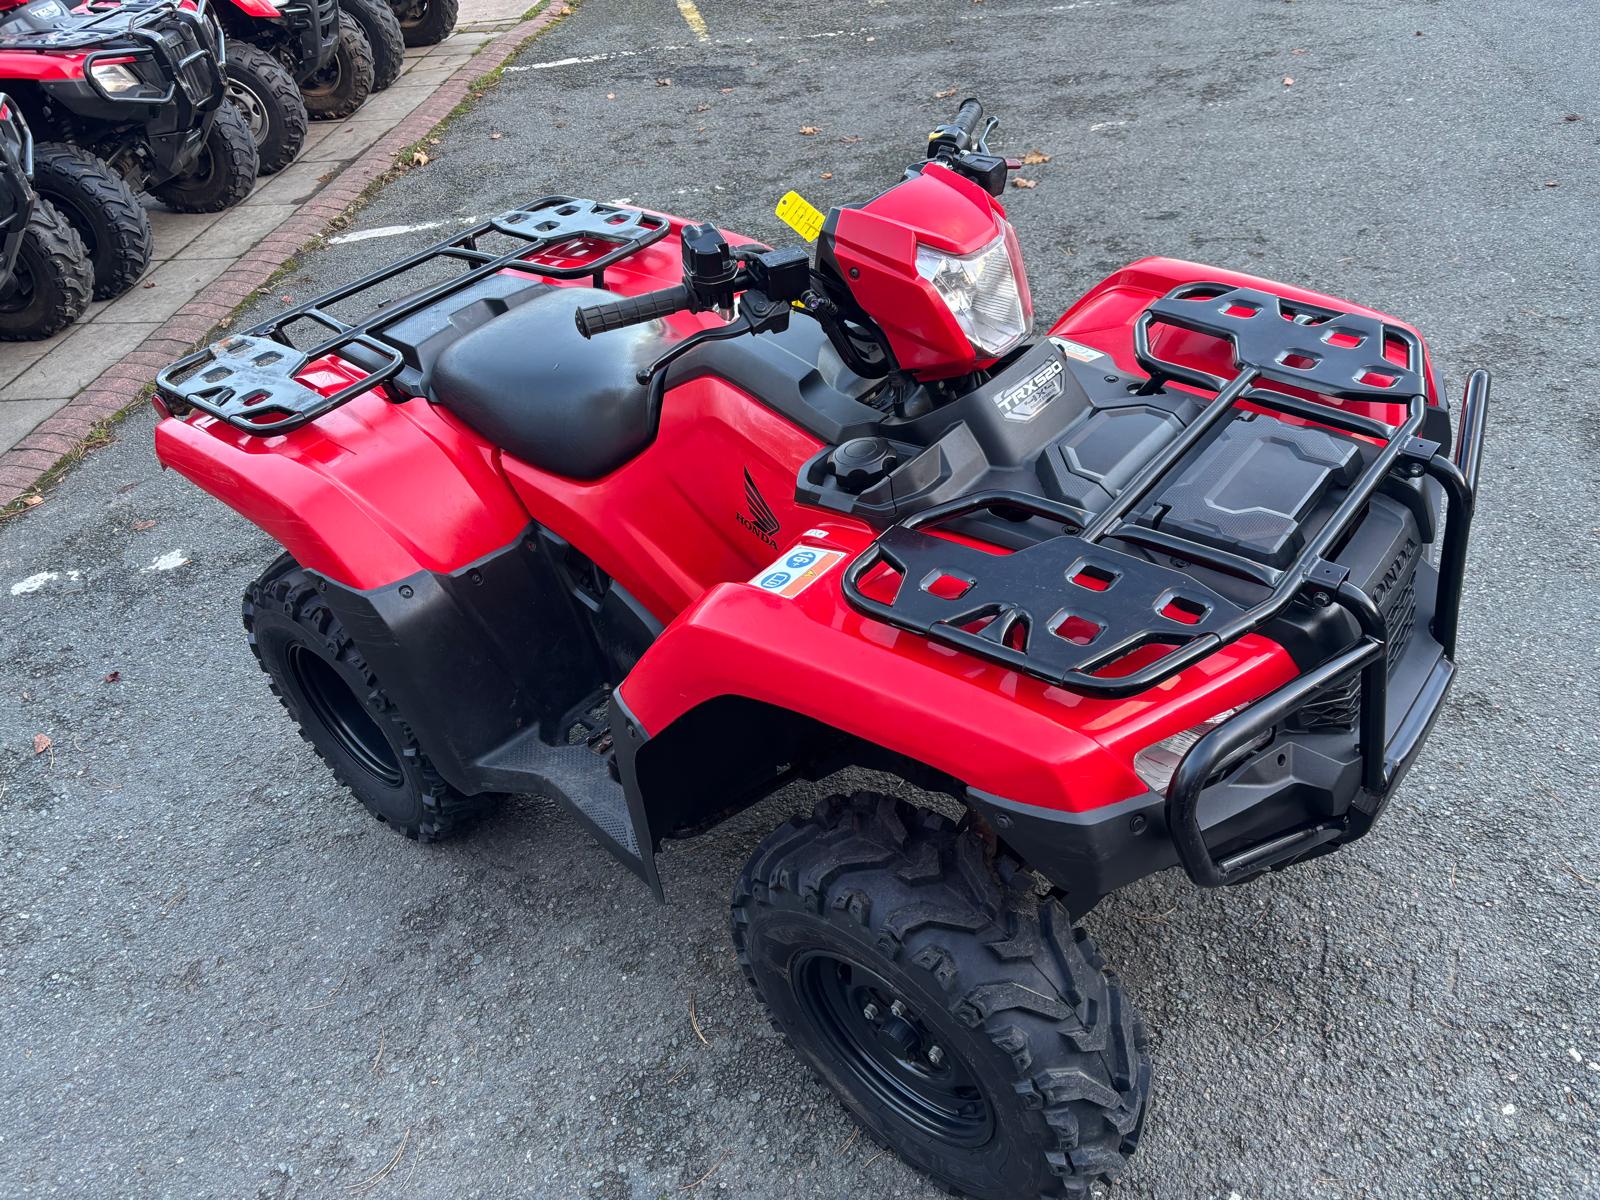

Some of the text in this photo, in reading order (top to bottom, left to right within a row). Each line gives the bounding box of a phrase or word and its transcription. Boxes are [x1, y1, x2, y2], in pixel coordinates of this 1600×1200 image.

[997, 361, 1063, 411] TRX520
[735, 511, 779, 551] HONDA
[792, 552, 814, 567] 16+
[1372, 537, 1418, 608] ONDA
